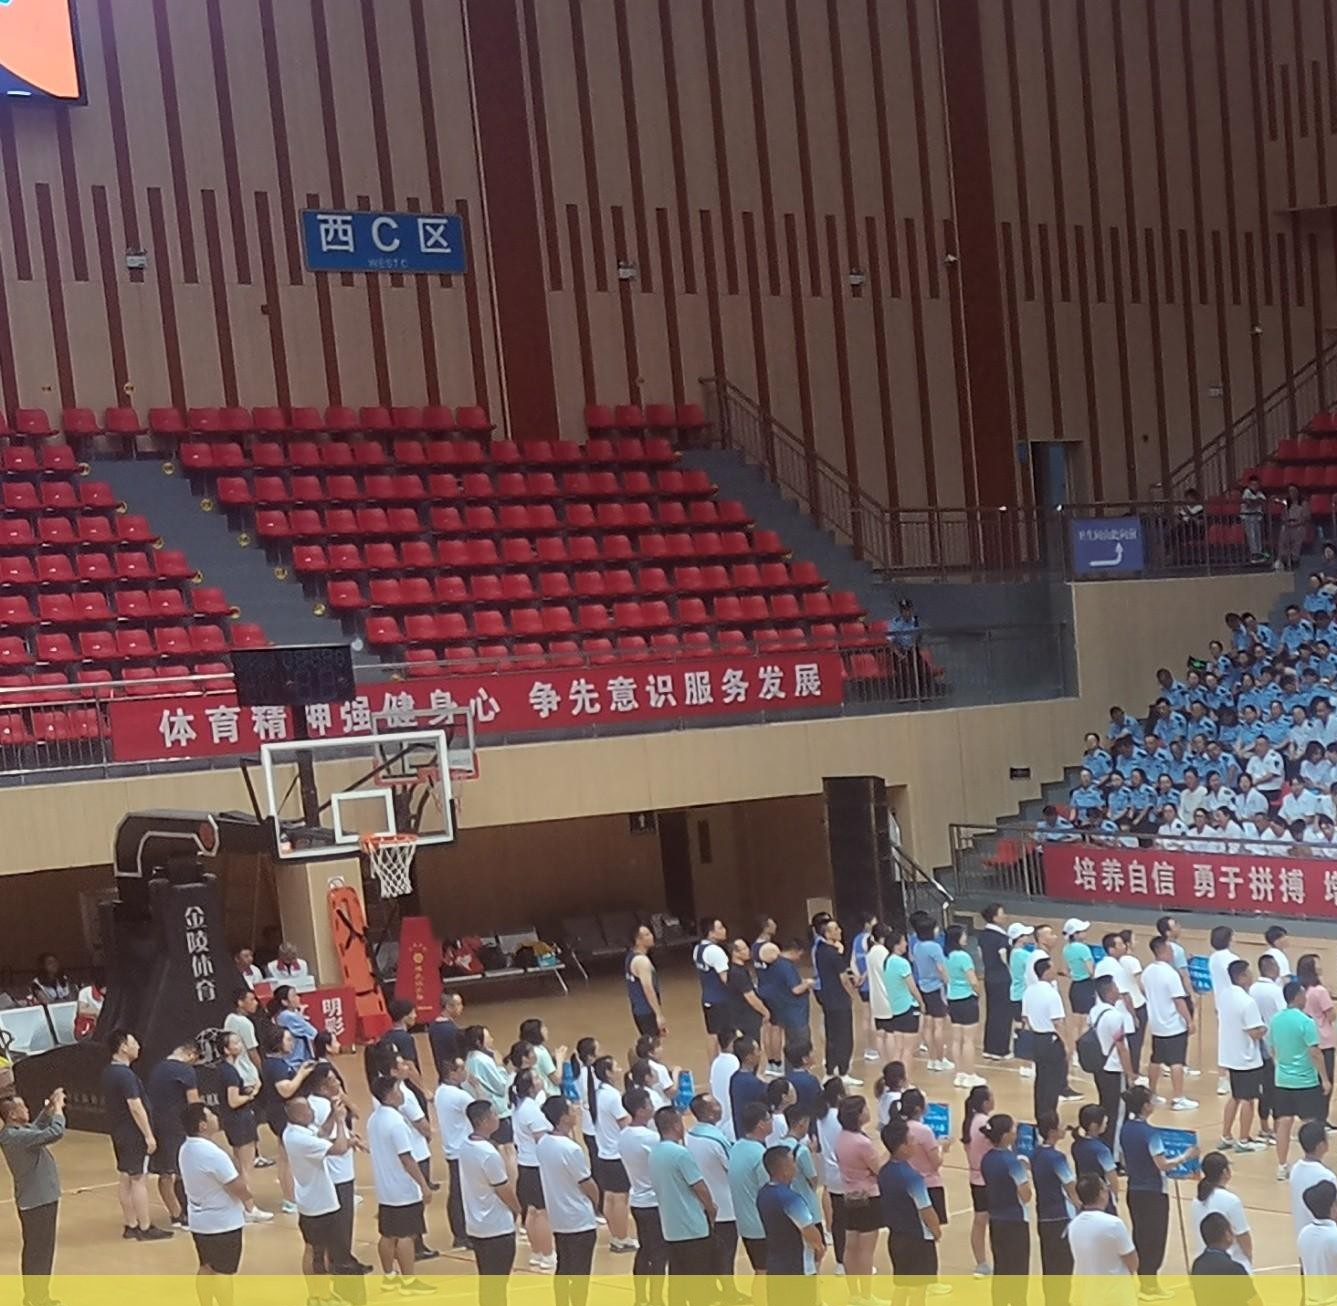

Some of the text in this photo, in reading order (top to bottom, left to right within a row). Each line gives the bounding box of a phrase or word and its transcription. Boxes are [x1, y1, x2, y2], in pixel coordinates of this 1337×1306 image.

[528, 662, 824, 718] 争先意识服务发展
[1073, 857, 1176, 897] 培养自信
[1193, 863, 1306, 904] 勇于拼搏
[185, 905, 216, 1002] 金陵体育
